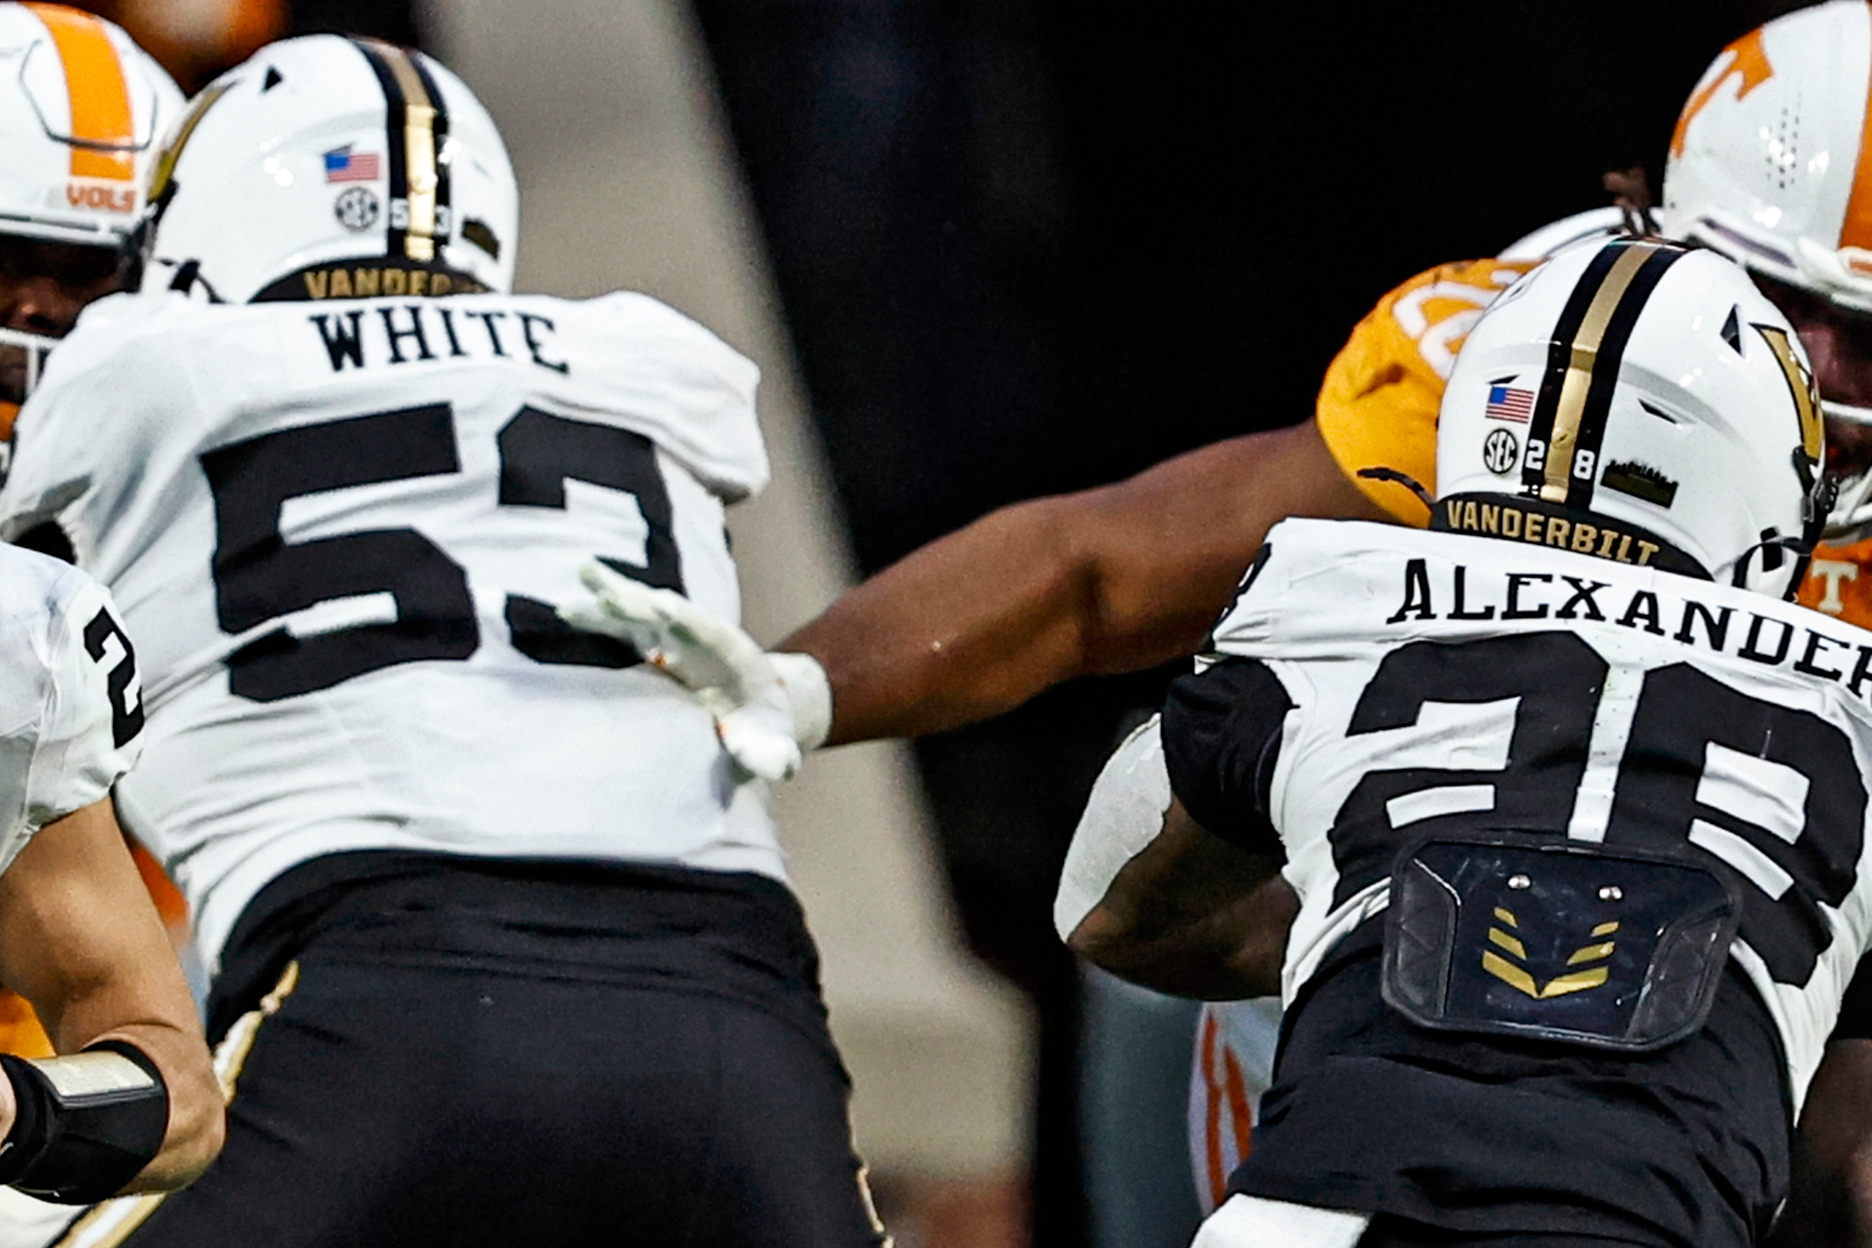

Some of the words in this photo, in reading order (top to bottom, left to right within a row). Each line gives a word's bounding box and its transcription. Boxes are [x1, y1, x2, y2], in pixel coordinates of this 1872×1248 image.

[308, 304, 569, 374] WHITE
[1484, 428, 1518, 474] SEC
[1525, 439, 1546, 471] 2
[1573, 449, 1596, 480] 8
[199, 402, 686, 703] 53
[1447, 500, 1660, 566] VANDERBILT
[1810, 559, 1859, 615] T
[84, 607, 145, 749] 2
[1326, 629, 1870, 990] 28
